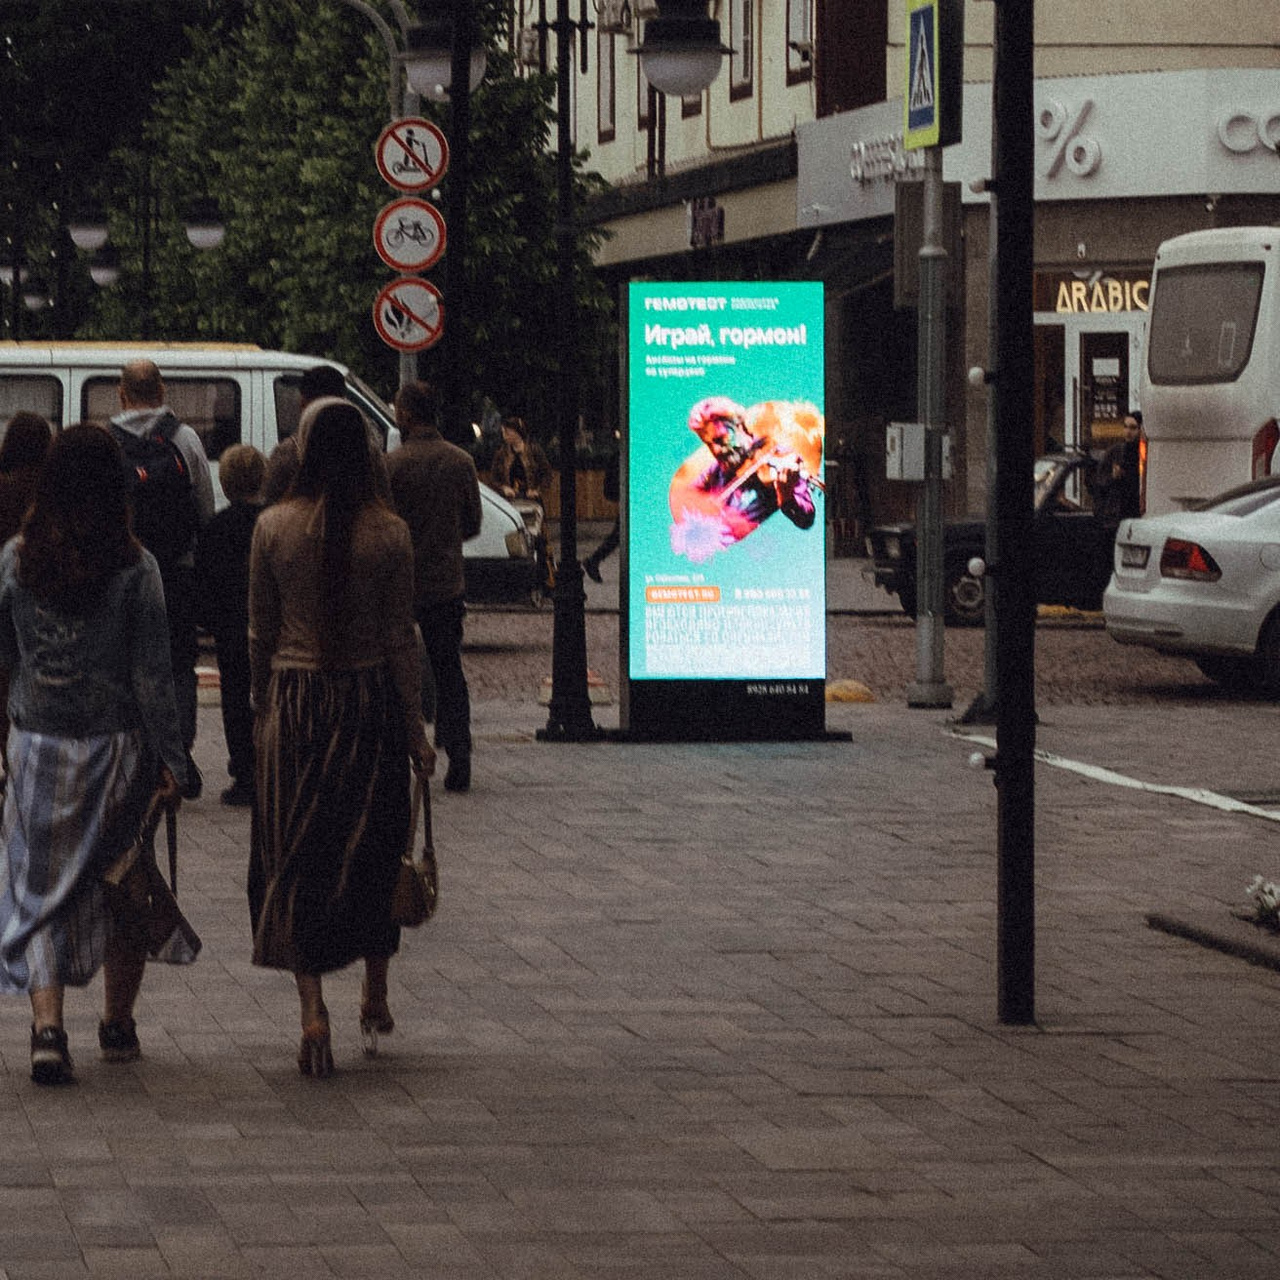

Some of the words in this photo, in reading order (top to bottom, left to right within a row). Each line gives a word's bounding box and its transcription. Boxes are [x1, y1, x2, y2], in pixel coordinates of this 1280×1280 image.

[1056, 280, 1150, 313] ARABIC
[644, 323, 715, 350] Играй,
[719, 323, 807, 350] гормон!
